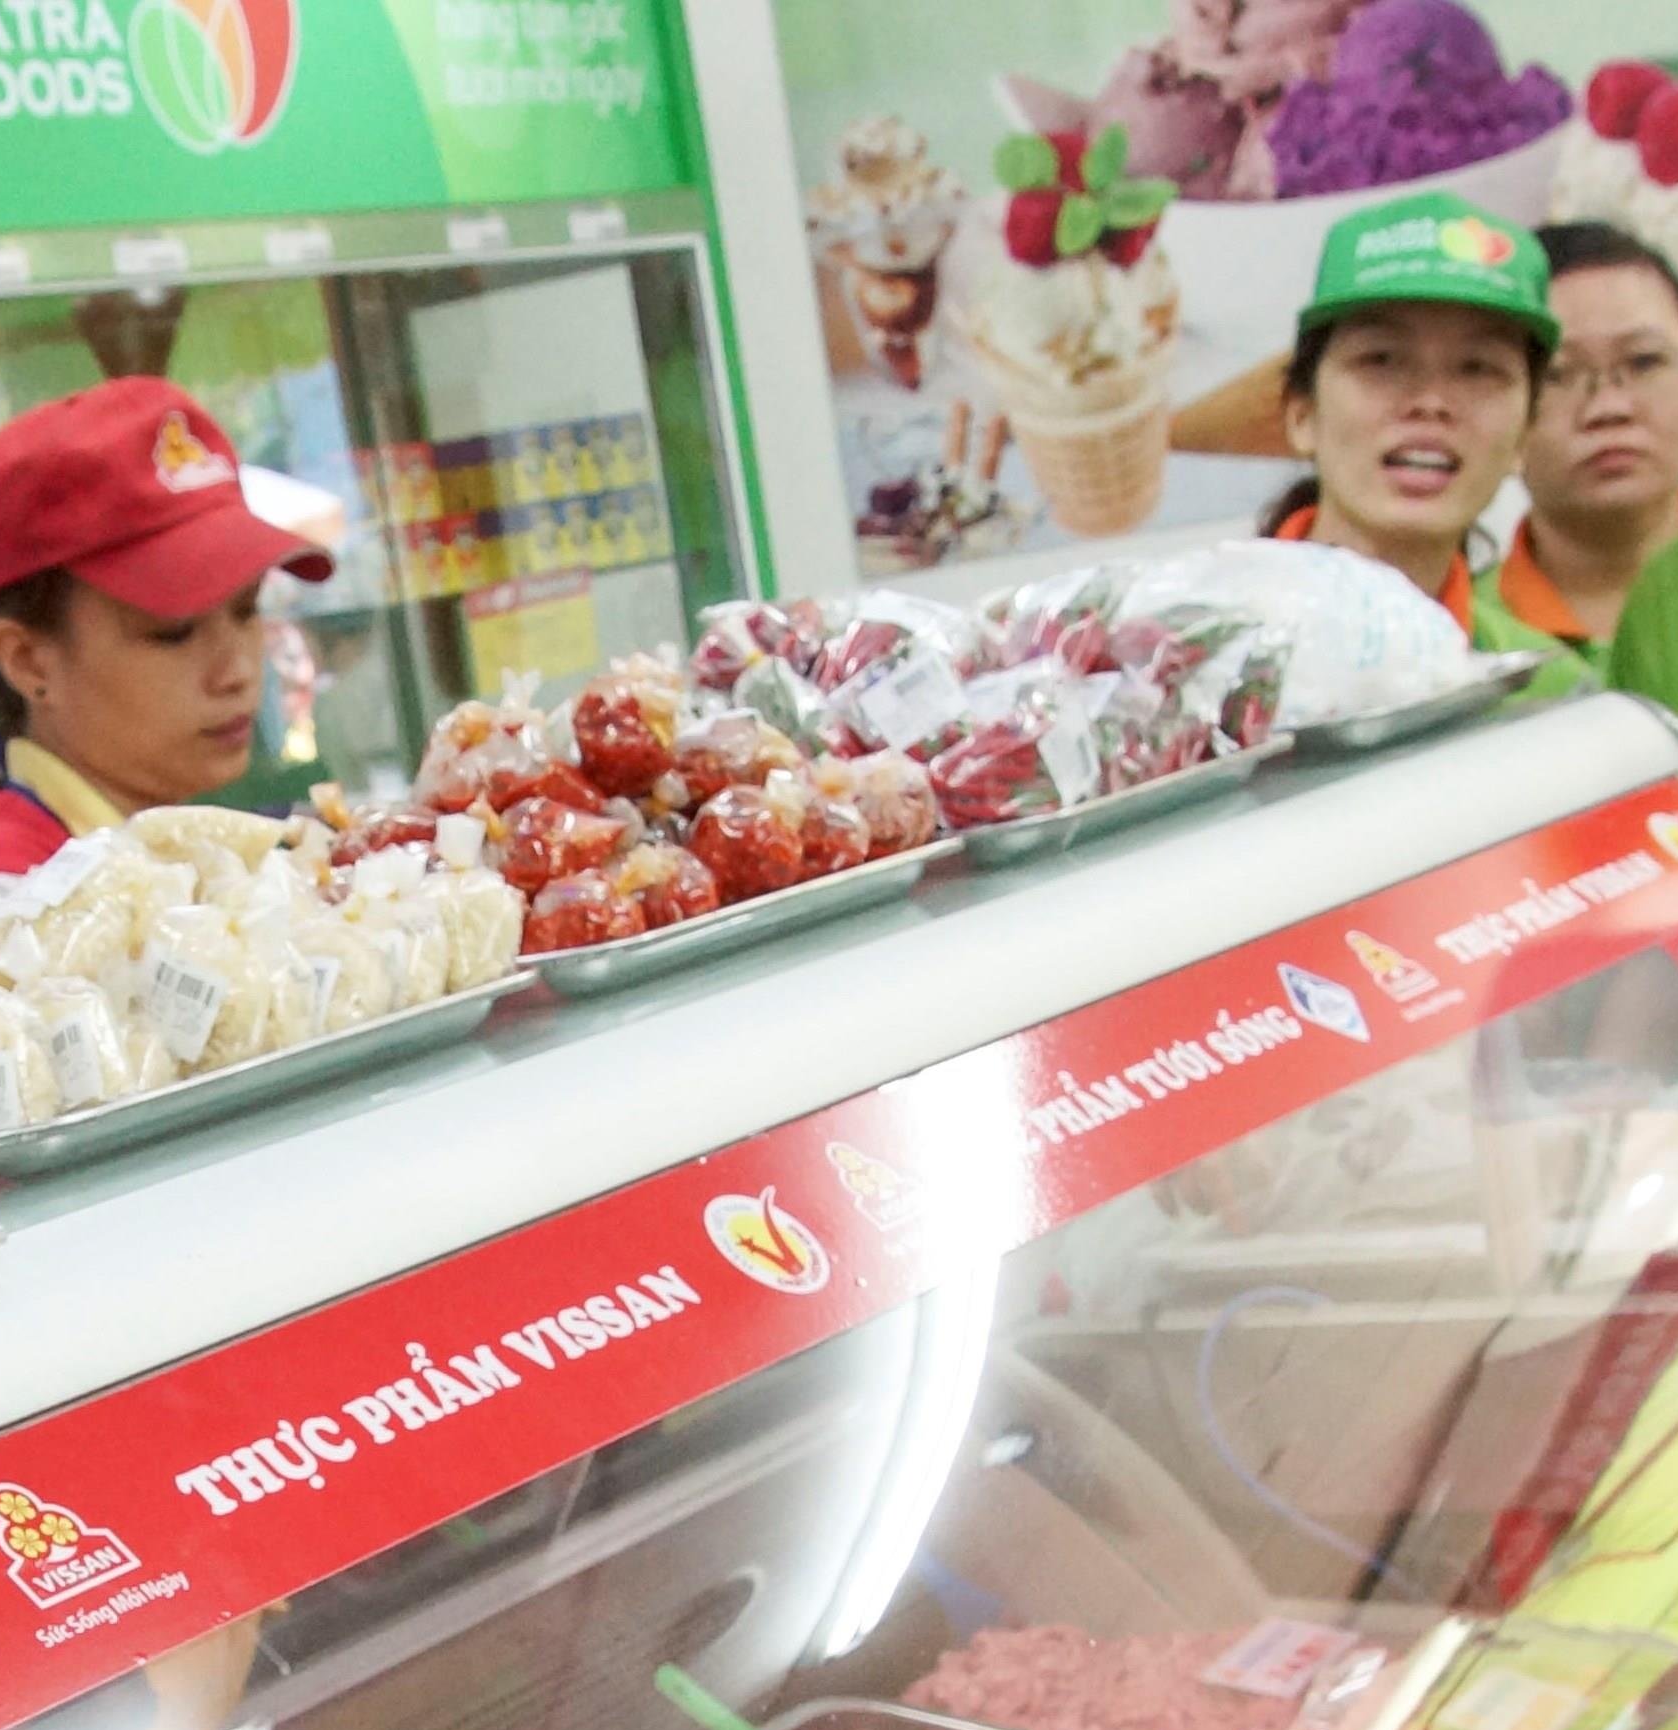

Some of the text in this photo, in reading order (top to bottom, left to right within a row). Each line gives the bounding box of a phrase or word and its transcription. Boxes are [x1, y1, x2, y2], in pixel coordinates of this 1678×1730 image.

[175, 1265, 702, 1516] THỰC PHẨM VISSAN
[31, 1545, 122, 1593] VISSAN
